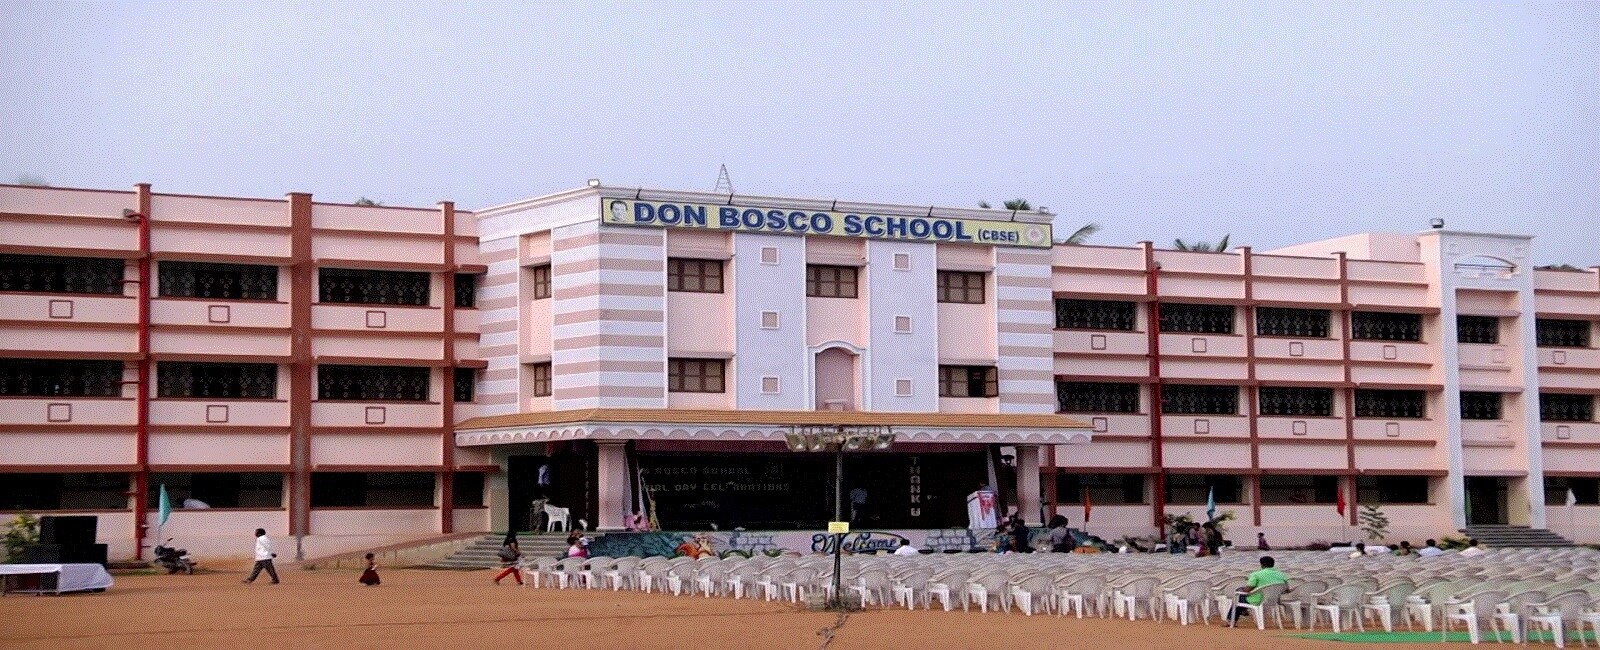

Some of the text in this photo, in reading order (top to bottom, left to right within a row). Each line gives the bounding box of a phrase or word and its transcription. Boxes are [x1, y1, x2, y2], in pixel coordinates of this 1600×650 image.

[633, 202, 1020, 243] DON BOSCO SCHOOL (CBSE)
